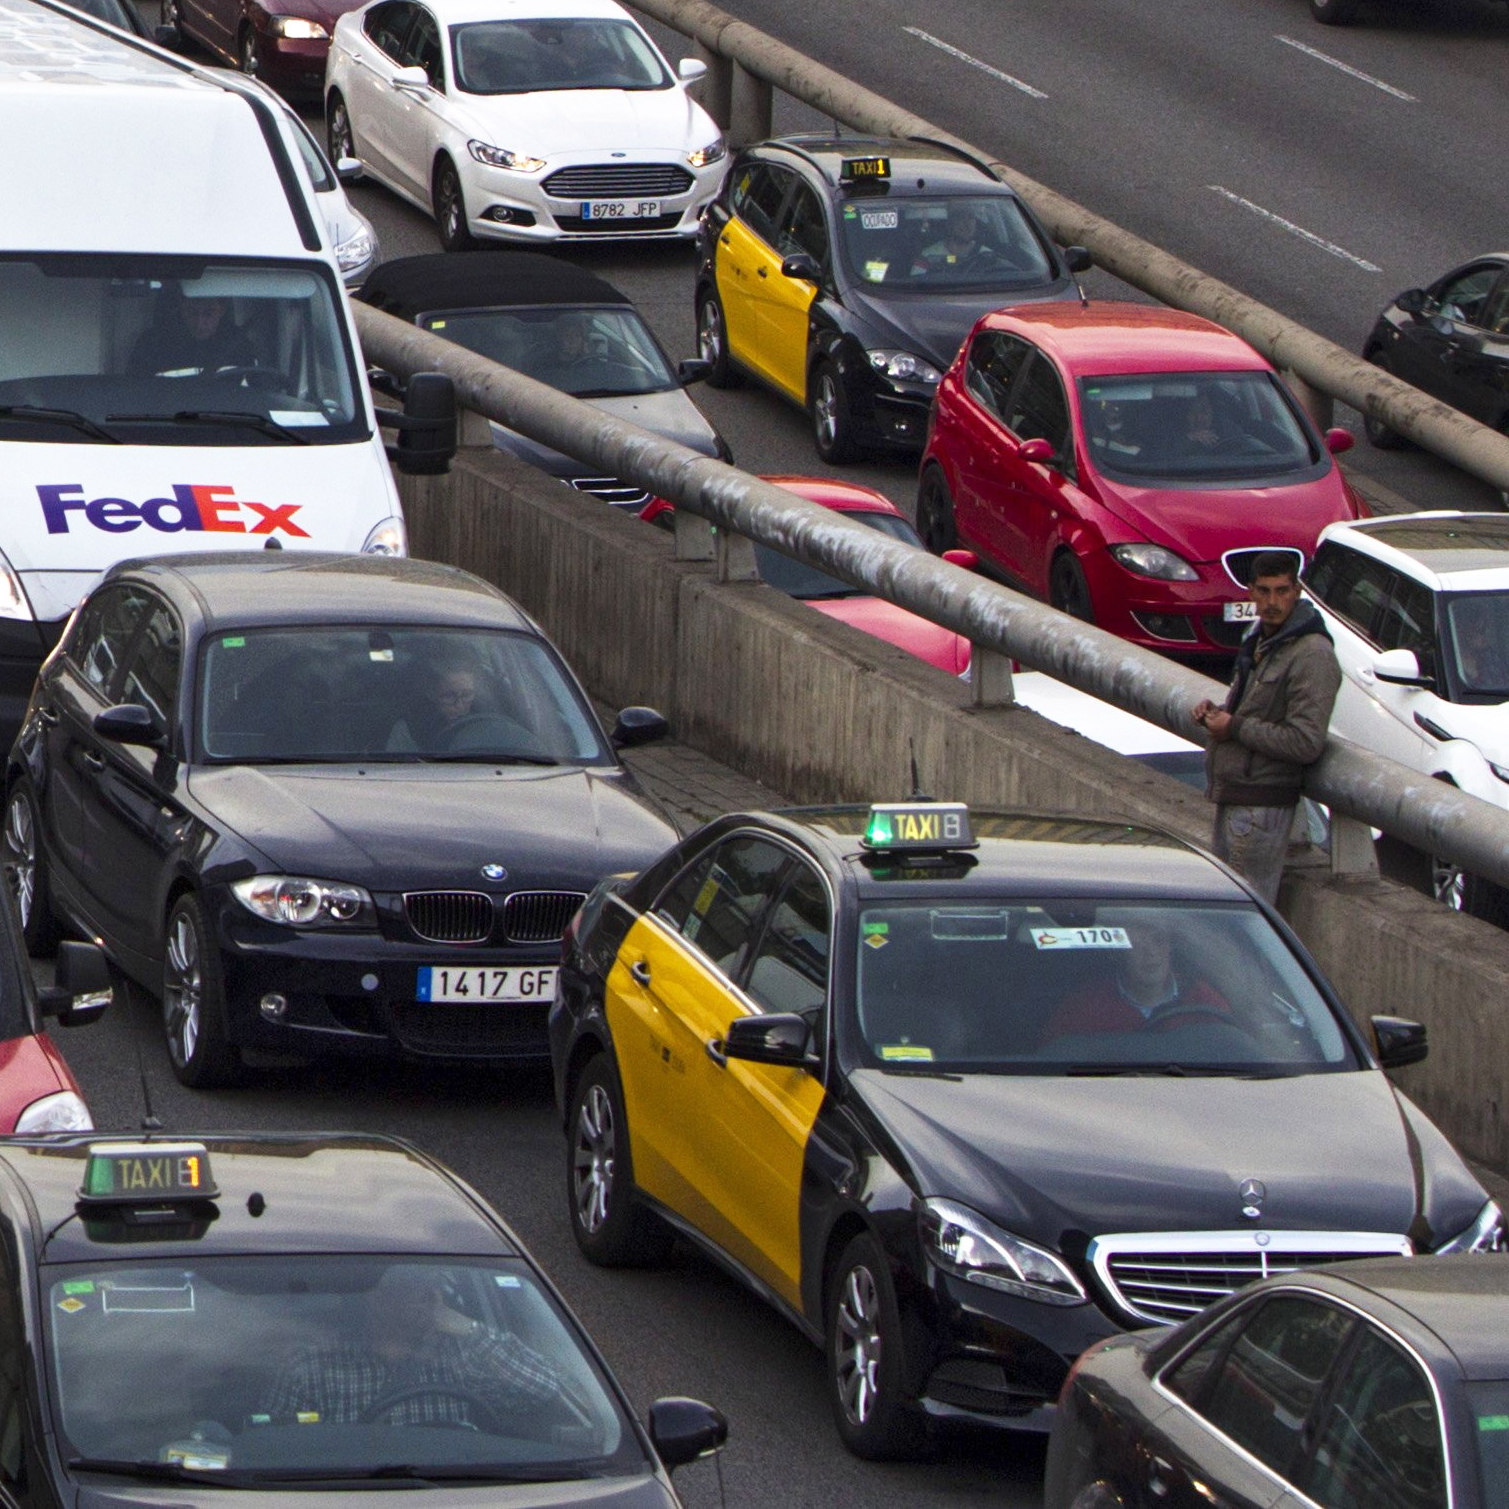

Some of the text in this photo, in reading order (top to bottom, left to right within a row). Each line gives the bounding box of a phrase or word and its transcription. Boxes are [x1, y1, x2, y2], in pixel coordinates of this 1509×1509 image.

[852, 161, 877, 176] TAXI
[592, 202, 658, 218] 8782 JFP
[35, 483, 312, 539] FedEx
[894, 814, 940, 841] TAXI
[1076, 930, 1114, 944] 170
[440, 969, 555, 998] 1417 GF
[119, 1159, 171, 1188] TAXI
